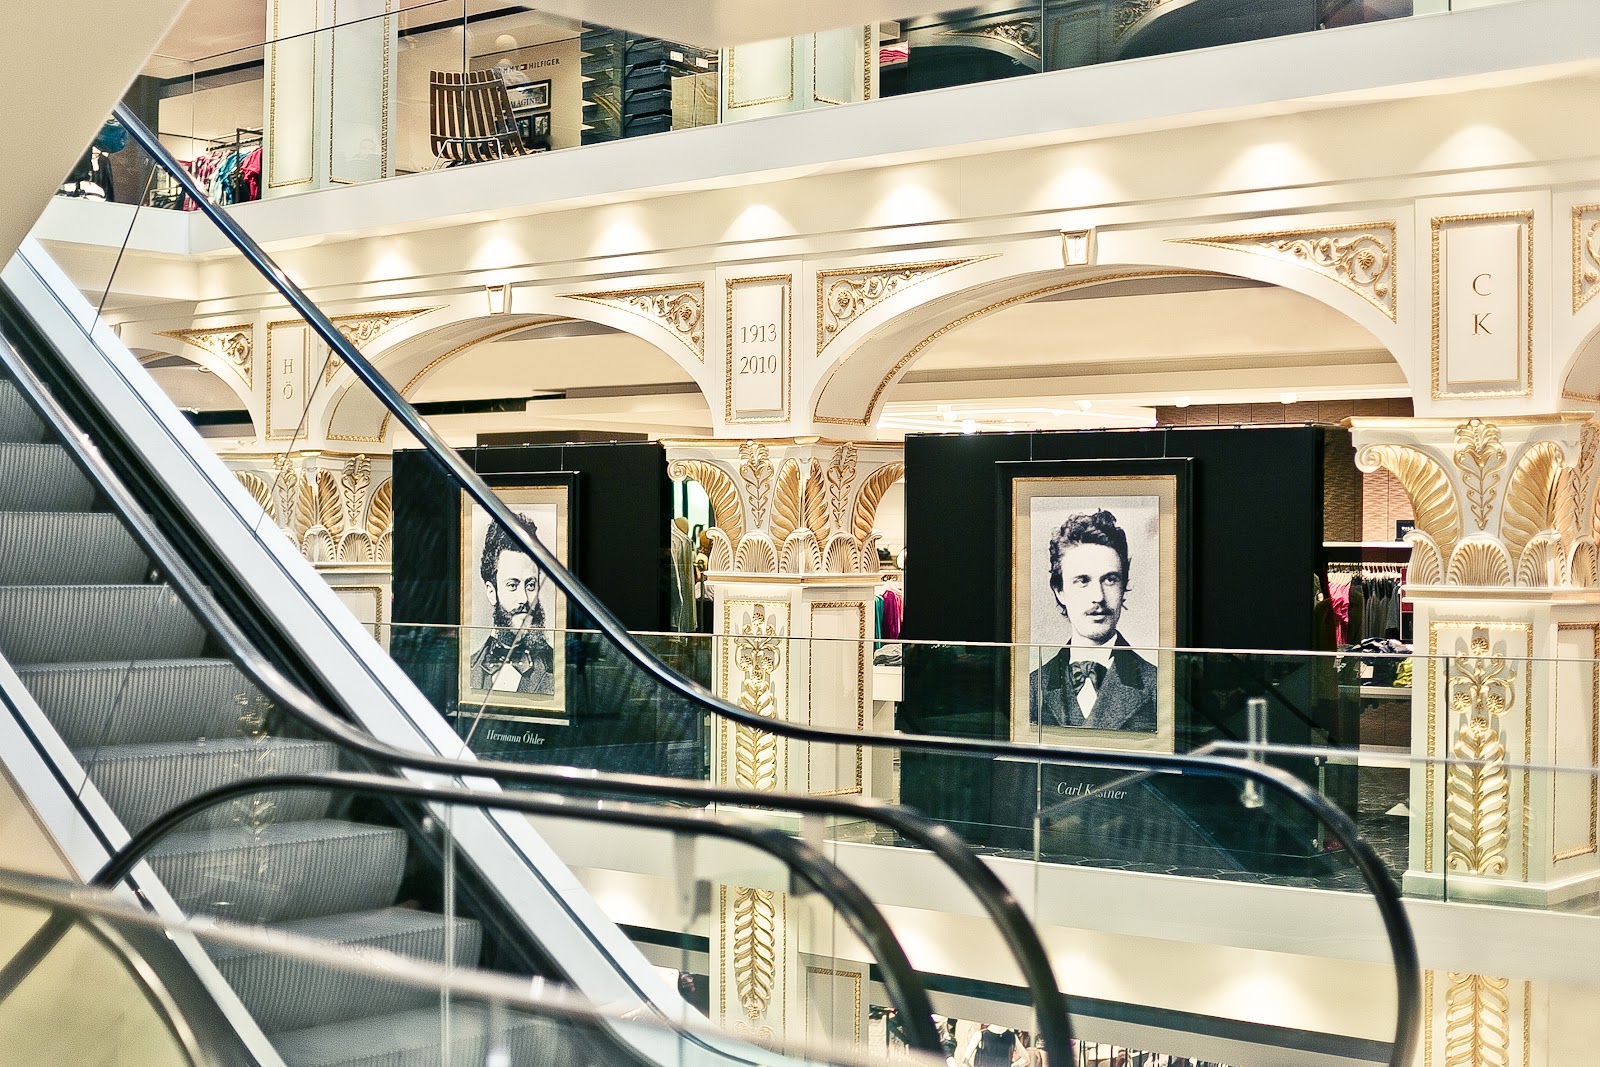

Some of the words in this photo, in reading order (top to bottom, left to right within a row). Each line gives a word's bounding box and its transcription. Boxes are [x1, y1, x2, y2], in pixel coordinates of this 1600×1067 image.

[528, 58, 560, 70] HILFIGER
[1472, 273, 1492, 297] C
[740, 323, 777, 344] 1913
[1471, 312, 1493, 336] K
[282, 358, 294, 375] H
[740, 354, 777, 375] 2010
[486, 729, 521, 744] Hermann
[522, 730, 546, 745] Öhler
[1057, 781, 1083, 796] Carl
[1084, 783, 1128, 800] Kstner
